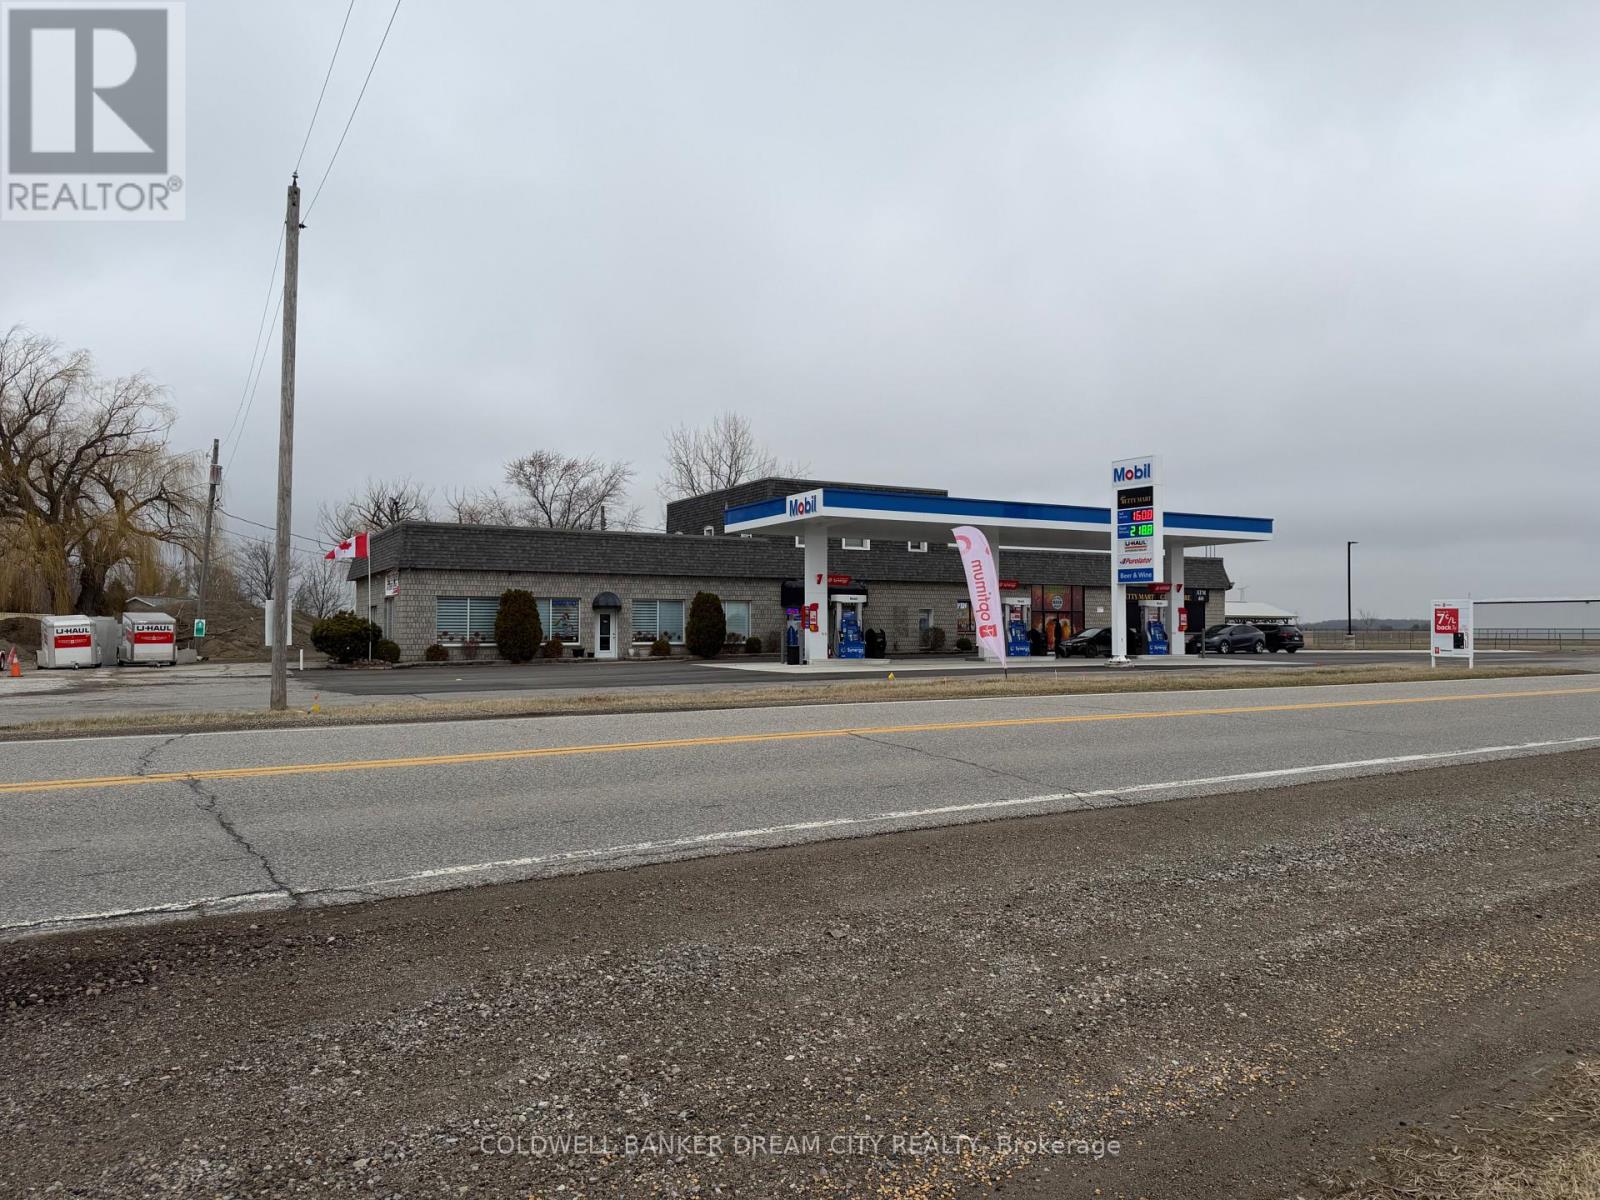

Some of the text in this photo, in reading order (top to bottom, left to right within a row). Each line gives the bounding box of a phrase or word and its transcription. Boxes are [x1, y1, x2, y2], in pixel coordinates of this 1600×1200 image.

[1113, 463, 1151, 482] Mobil
[789, 494, 817, 517] Mobil
[1125, 557, 1152, 565] Purolator
[1138, 571, 1152, 579] Wine
